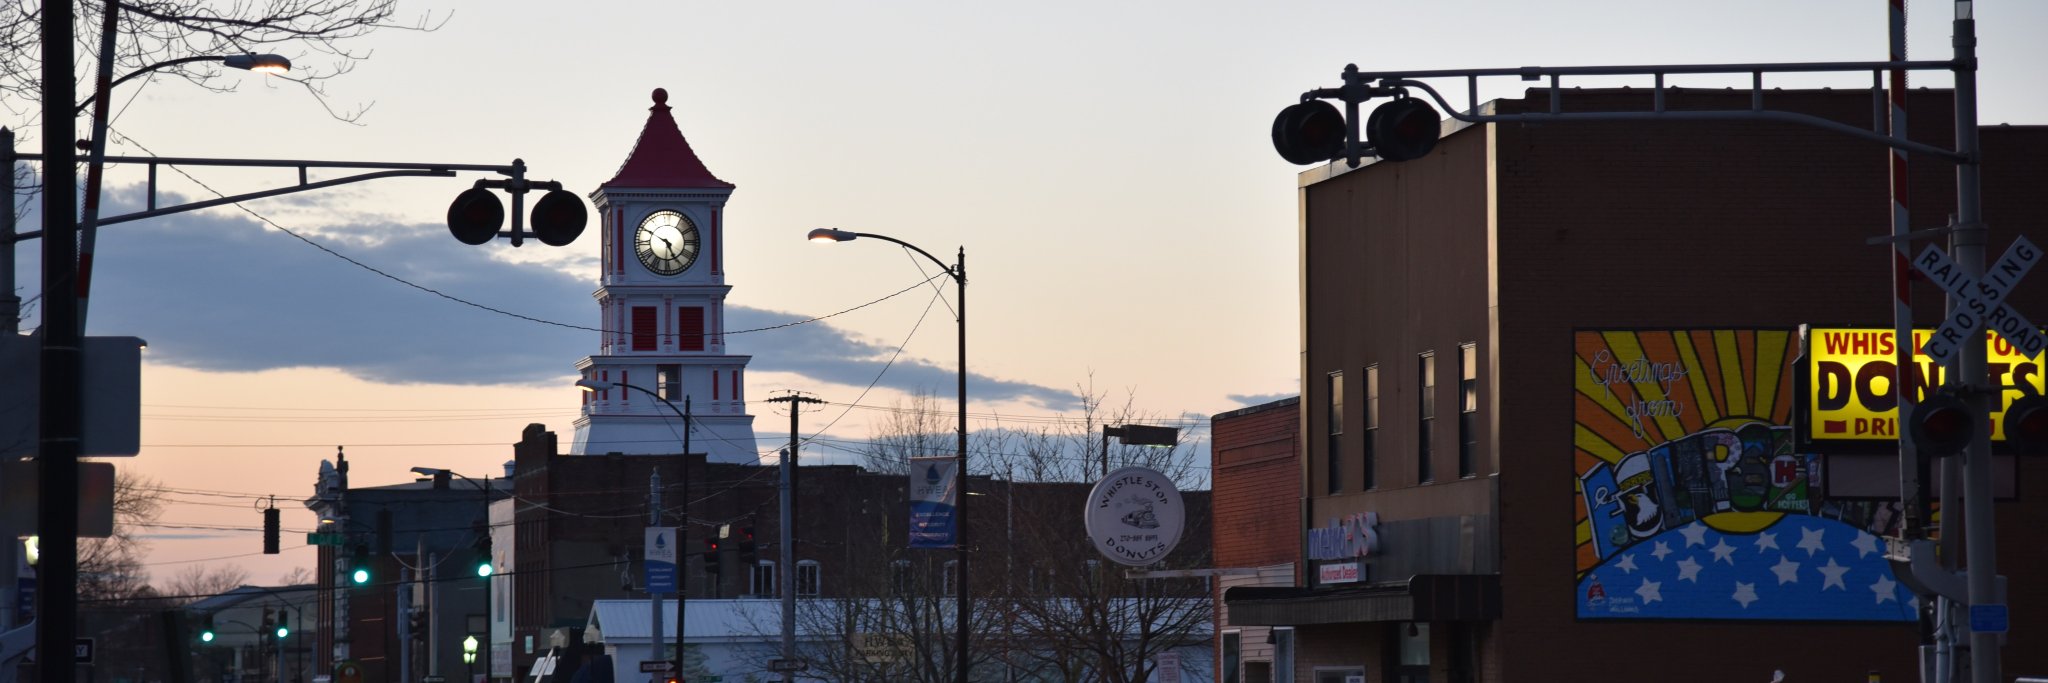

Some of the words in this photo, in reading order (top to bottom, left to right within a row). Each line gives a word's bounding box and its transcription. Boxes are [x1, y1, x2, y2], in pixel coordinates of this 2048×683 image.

[1930, 245, 2034, 358] CROSSING
[1591, 349, 1688, 400] Greetings
[1817, 361, 2039, 412] DONTS
[1626, 393, 1683, 439] from
[1100, 476, 1143, 508] WHISTLE
[1145, 480, 1168, 504] STOP
[1106, 537, 1165, 559] DONUTS
